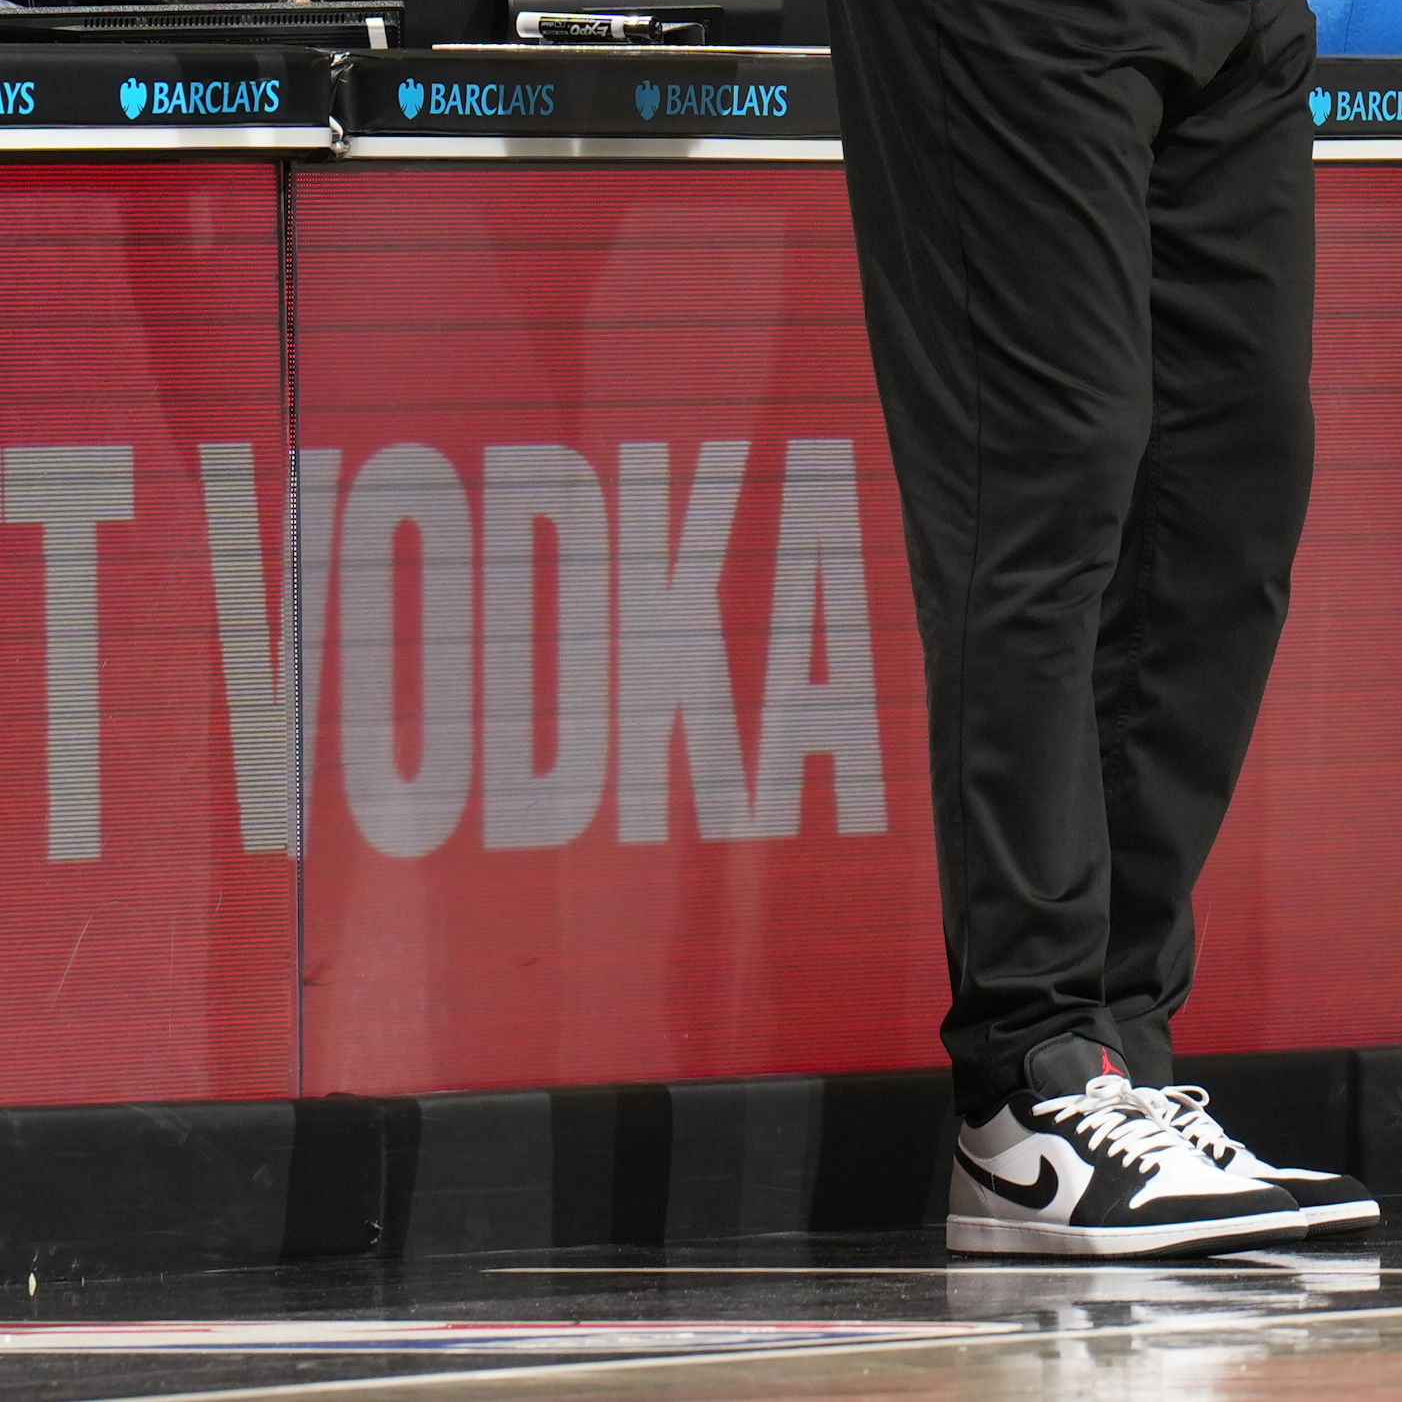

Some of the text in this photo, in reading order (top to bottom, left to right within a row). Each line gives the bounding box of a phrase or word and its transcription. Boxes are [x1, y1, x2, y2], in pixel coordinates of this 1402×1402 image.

[569, 21, 609, 37] EXPO
[0, 81, 35, 115] YS
[152, 80, 280, 114] BARCLAYS
[429, 82, 555, 116] BARCLAYS
[666, 85, 788, 117] BARCLAYS
[198, 439, 890, 860] VODKA
